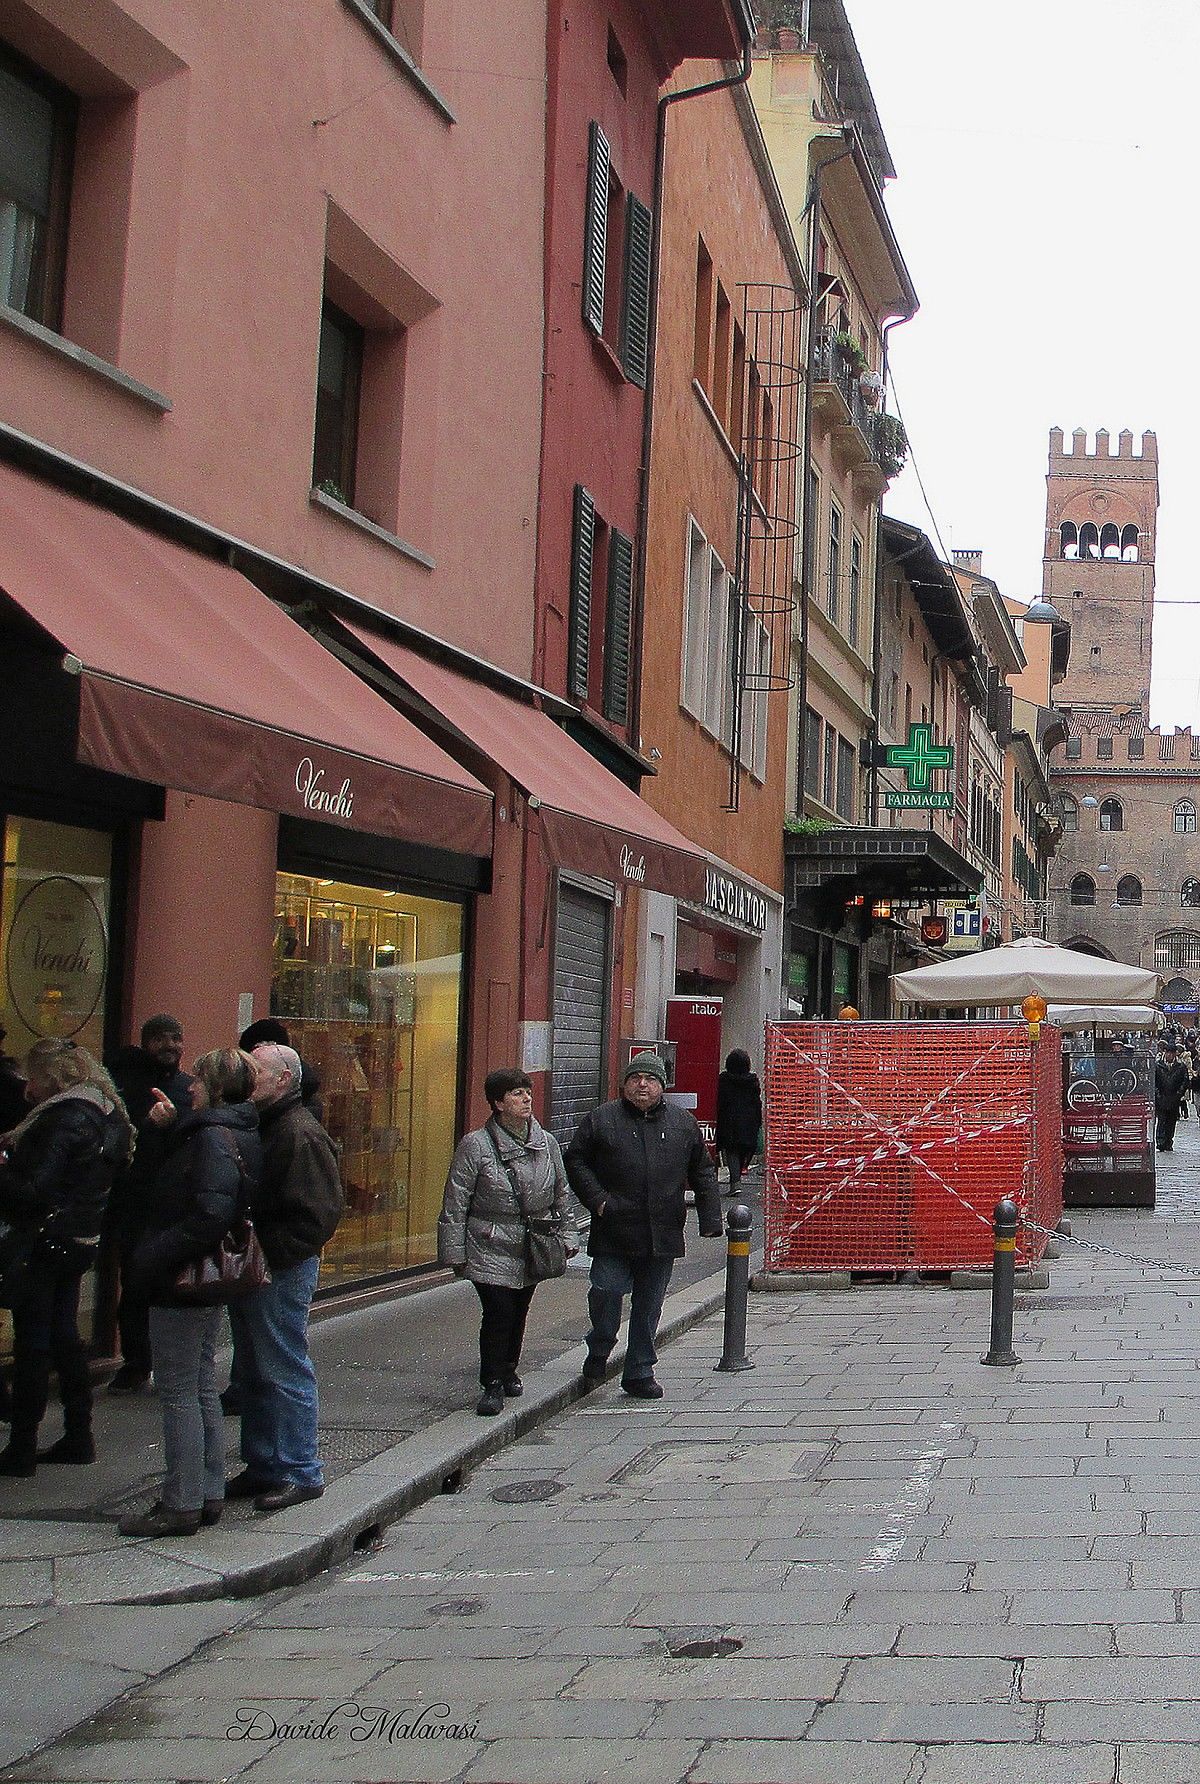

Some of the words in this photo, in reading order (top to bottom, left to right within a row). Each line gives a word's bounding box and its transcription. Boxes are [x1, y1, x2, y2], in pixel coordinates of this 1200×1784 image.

[296, 757, 354, 818] Venchi
[887, 794, 951, 807] FARMACIA
[619, 844, 646, 882] Venchi
